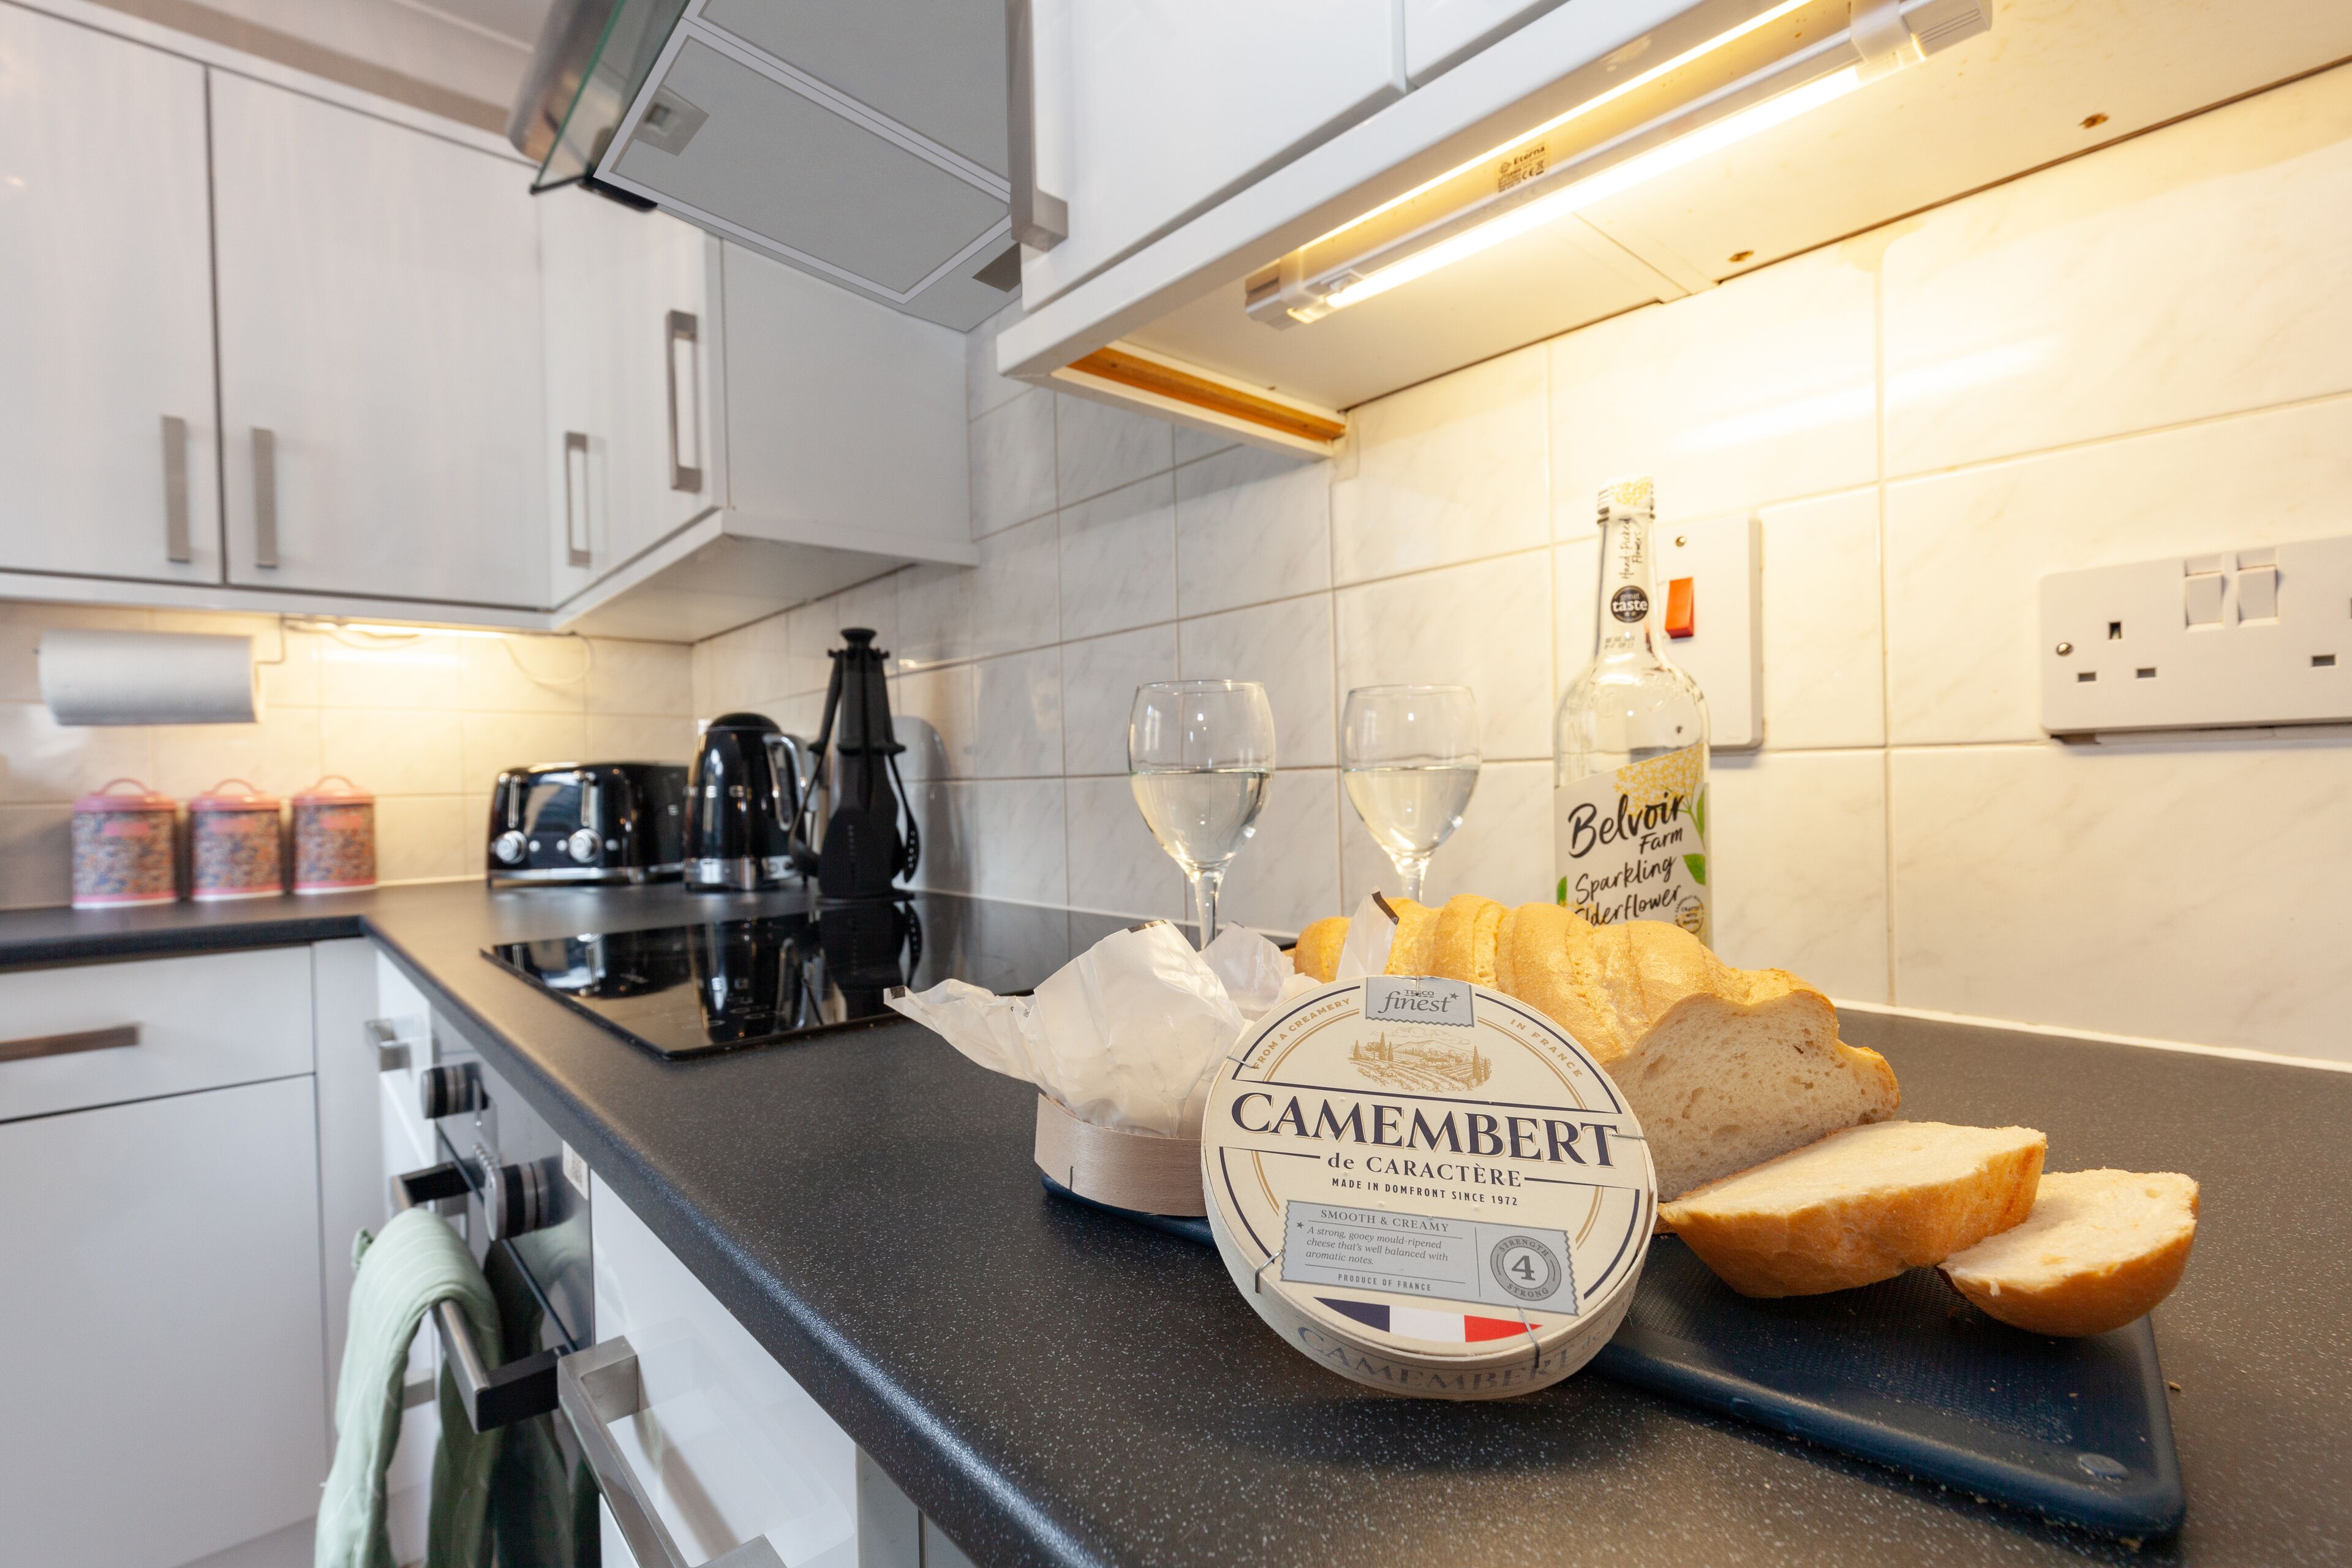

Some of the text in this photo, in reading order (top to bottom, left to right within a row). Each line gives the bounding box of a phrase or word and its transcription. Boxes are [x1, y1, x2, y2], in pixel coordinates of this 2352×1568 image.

[1513, 146, 1545, 165] Eterna
[1612, 599, 1648, 612] taste
[1568, 792, 1684, 858] Belvoir
[1639, 827, 1683, 854] Farm
[1575, 856, 1677, 904] Sparkling
[1378, 990, 1451, 1014] finest
[1253, 1041, 1278, 1070] FROM
[1289, 998, 1350, 1031] CREAMERY
[1510, 1019, 1583, 1077] IN FRANCE
[1231, 1092, 1618, 1167] CAMEMBERT
[1327, 1153, 1521, 1187] de CARACTÈRE
[1332, 1178, 1518, 1205] MADE IN DOMFRONT SINCE 1972
[1321, 1210, 1449, 1232] SMOOTH & CREAMY
[1306, 1238, 1449, 1262] cheese that's well balanced with
[1317, 1229, 1346, 1239] strong,
[1349, 1233, 1374, 1243] gooey
[1377, 1235, 1442, 1249] mould-ripened
[1499, 1239, 1550, 1257] STRENGTH
[1305, 1250, 1374, 1265] aromatic notes.
[1511, 1255, 1536, 1281] 4
[1338, 1273, 1377, 1284] PRODUCE
[1398, 1280, 1431, 1291] FRANCE
[1507, 1283, 1548, 1297] STRONG
[1297, 1327, 1569, 1392] CAMEMBERT
